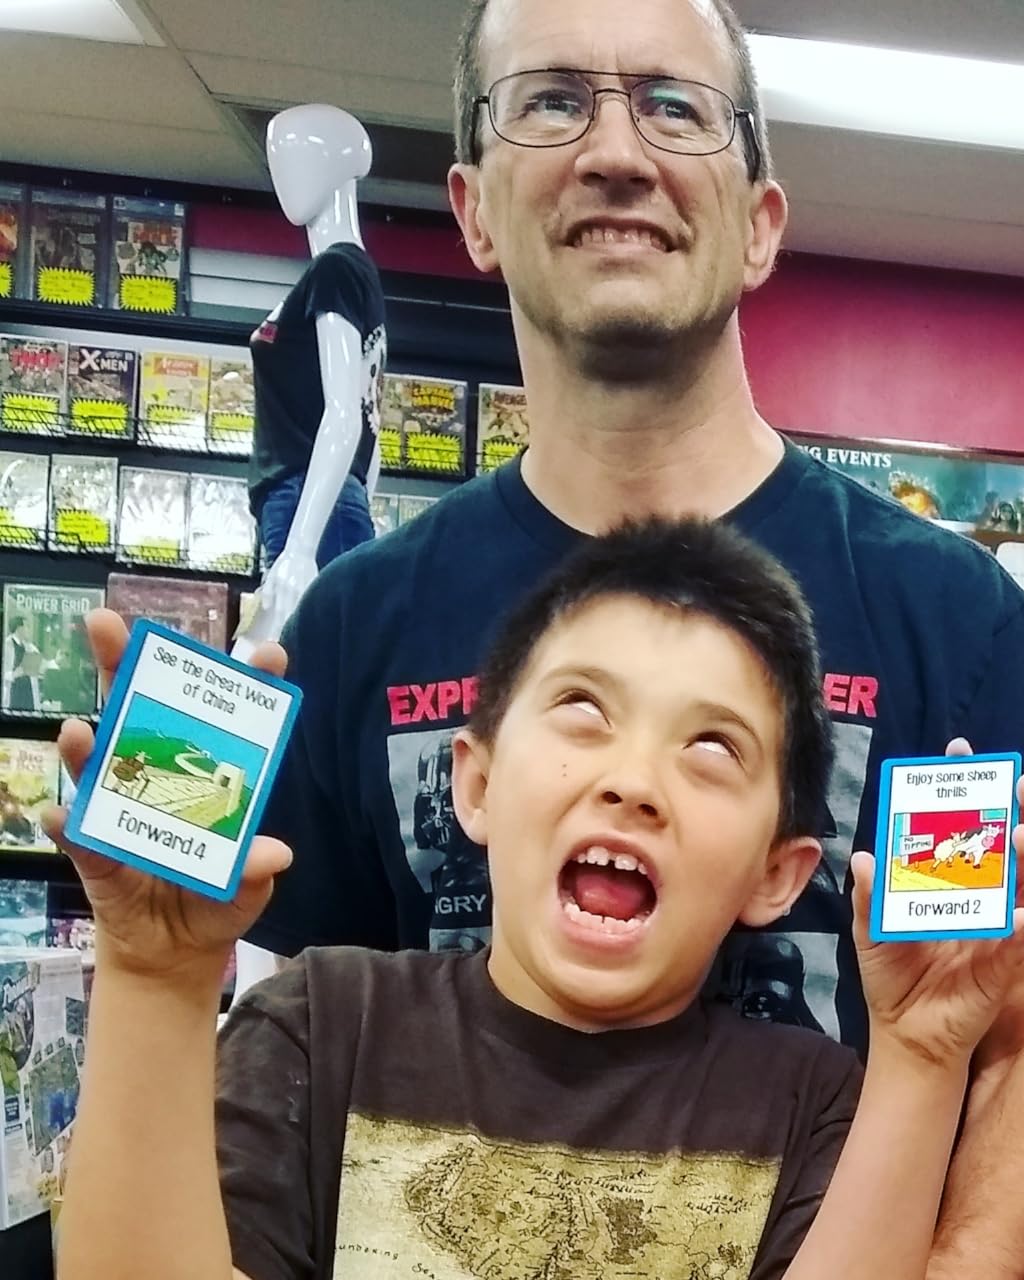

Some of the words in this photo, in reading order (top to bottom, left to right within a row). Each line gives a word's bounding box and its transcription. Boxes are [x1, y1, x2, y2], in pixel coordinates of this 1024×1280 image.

[79, 348, 129, 373] X-MEN
[827, 448, 892, 468] EVENTS
[16, 593, 58, 612] POWER
[61, 599, 90, 612] GRID
[153, 646, 178, 668] See
[182, 657, 204, 676] the
[204, 668, 243, 697] Great
[245, 686, 278, 711] Wool
[183, 682, 199, 697] of
[201, 689, 236, 715] China
[823, 673, 879, 718] ER
[906, 772, 933, 787] Enjoy
[935, 771, 965, 784] some
[967, 769, 997, 783] sheep
[936, 786, 968, 798] thrills
[117, 810, 195, 855] Forward
[194, 843, 207, 861] 4
[908, 900, 970, 917] Forward
[973, 900, 981, 914] 2
